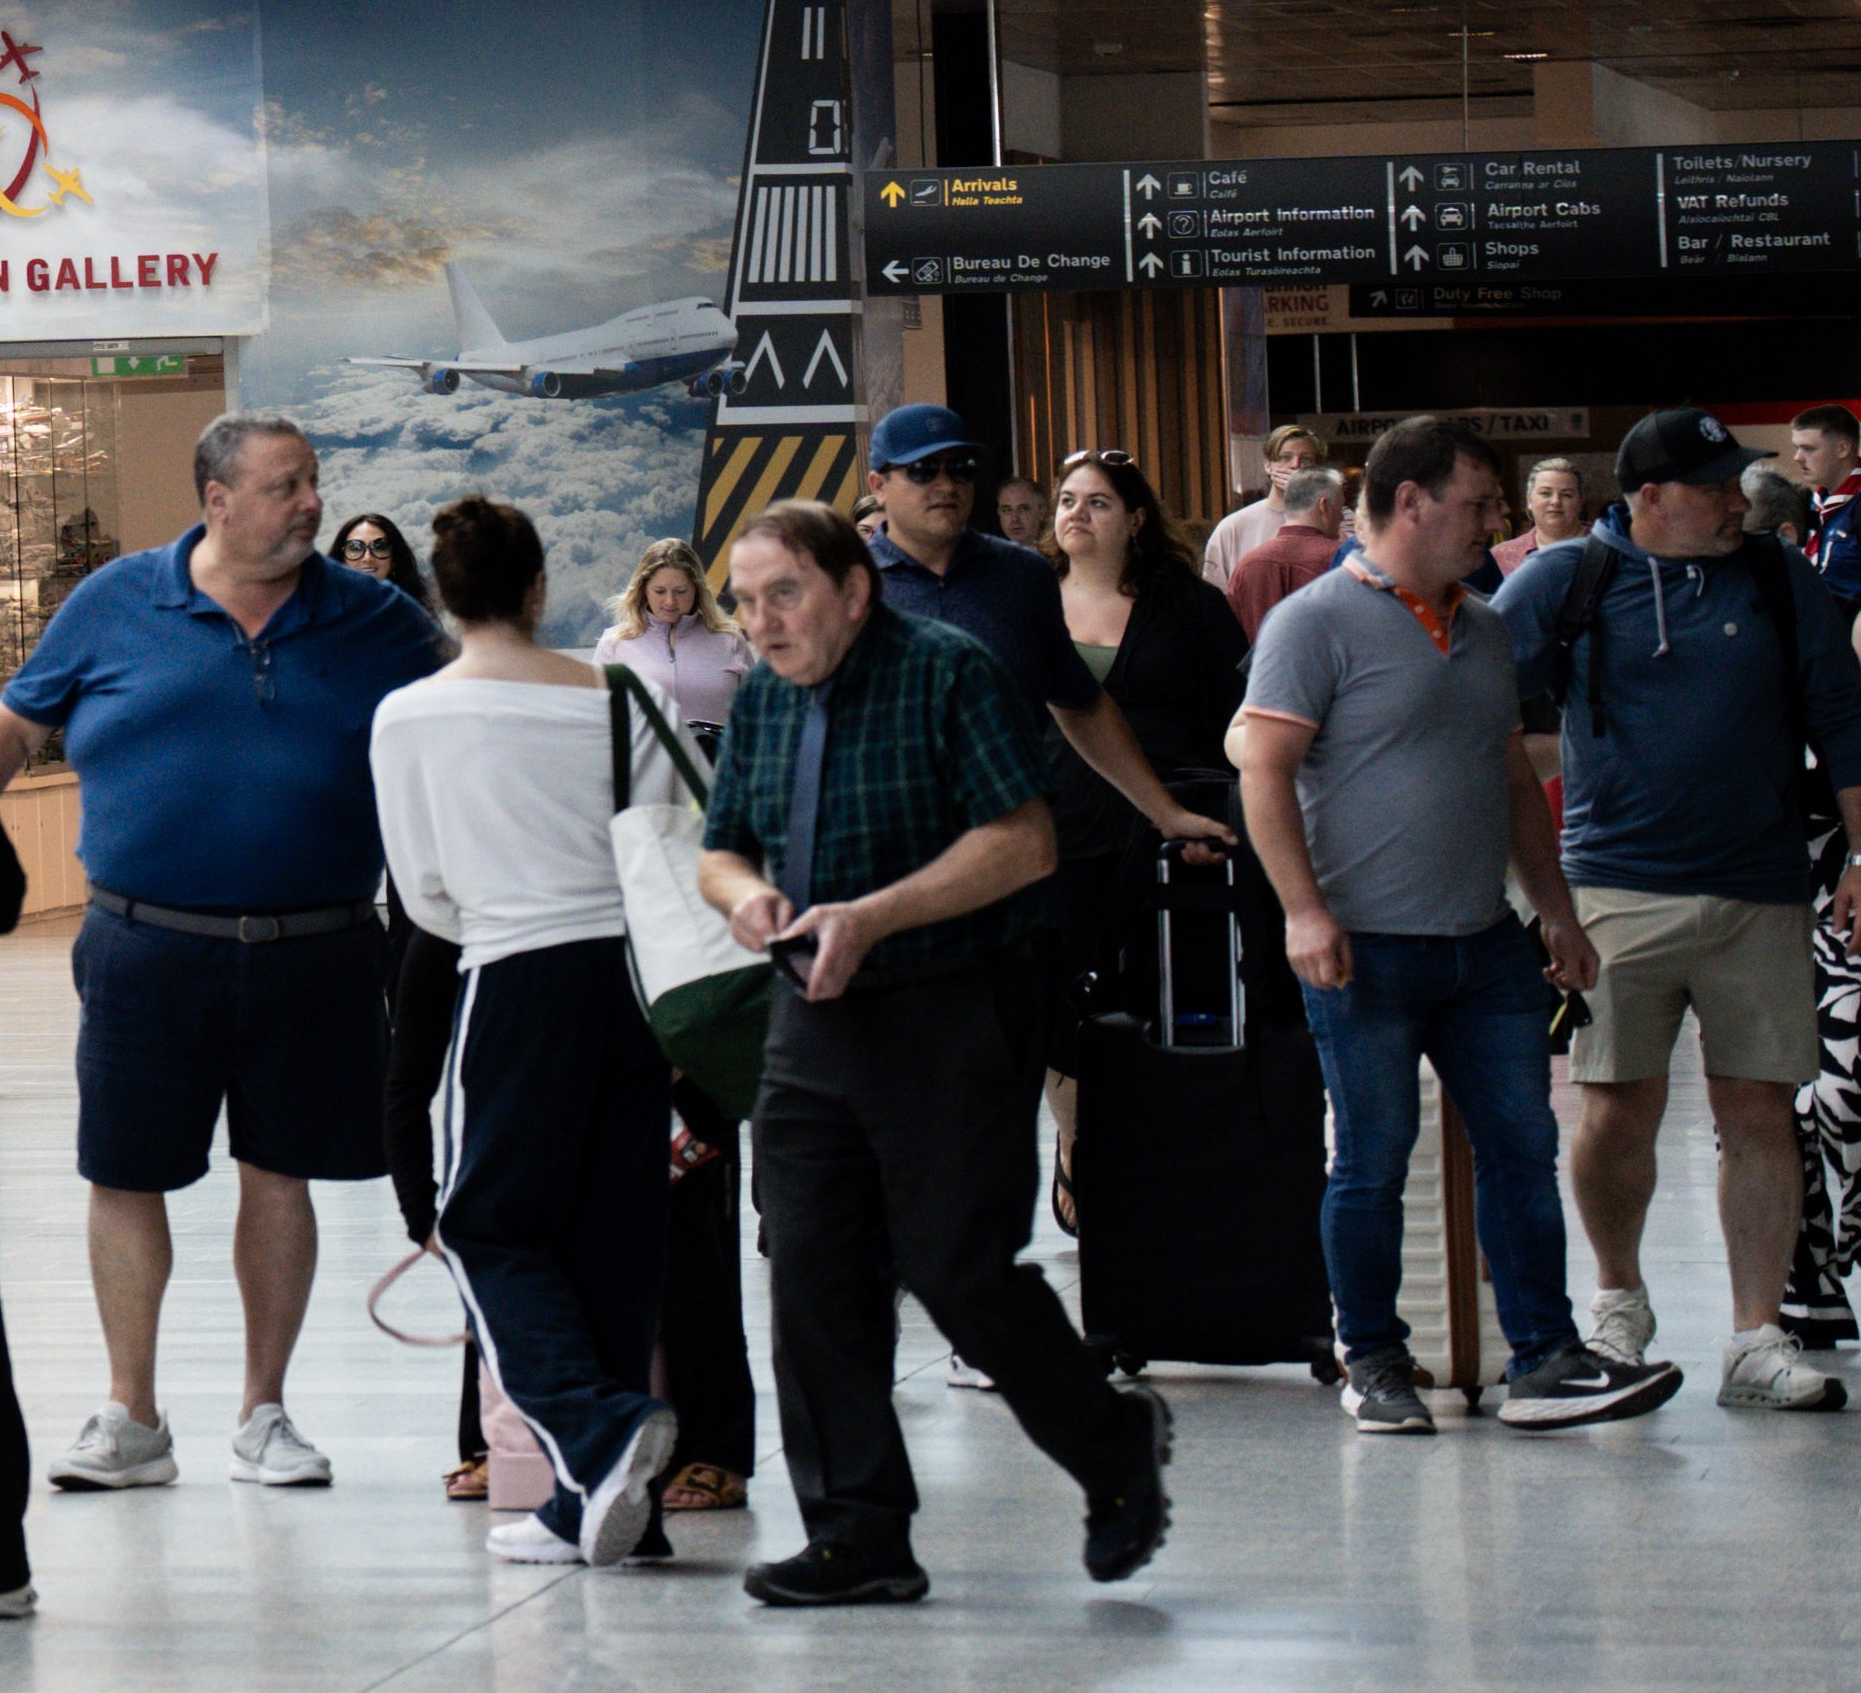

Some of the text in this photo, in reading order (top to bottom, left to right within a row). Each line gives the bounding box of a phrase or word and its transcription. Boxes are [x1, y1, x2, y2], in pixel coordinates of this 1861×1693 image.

[1485, 160, 1581, 176] Car Rental
[952, 177, 1018, 193] Arrivals
[1208, 169, 1248, 185] Café
[952, 195, 1023, 206] Halla Teachta
[1677, 193, 1789, 209] VAT Refunds
[1210, 206, 1375, 226] Airport Information
[1487, 202, 1601, 219] Airport Cabs
[1210, 228, 1239, 238] Eolas
[1678, 236, 1709, 250] Bar
[1731, 232, 1831, 248] Restaurant
[1211, 246, 1375, 264] Tourist Information
[1485, 241, 1540, 256] Shops
[953, 253, 1111, 272] Bureau De Change
[26, 252, 218, 292] GALLERY
[954, 273, 1049, 285] Bureau de Change
[1212, 267, 1240, 277] Eolas
[1434, 286, 1562, 302] Duty Free Shop
[1266, 294, 1329, 313] RKING
[1500, 414, 1548, 431] TAXI
